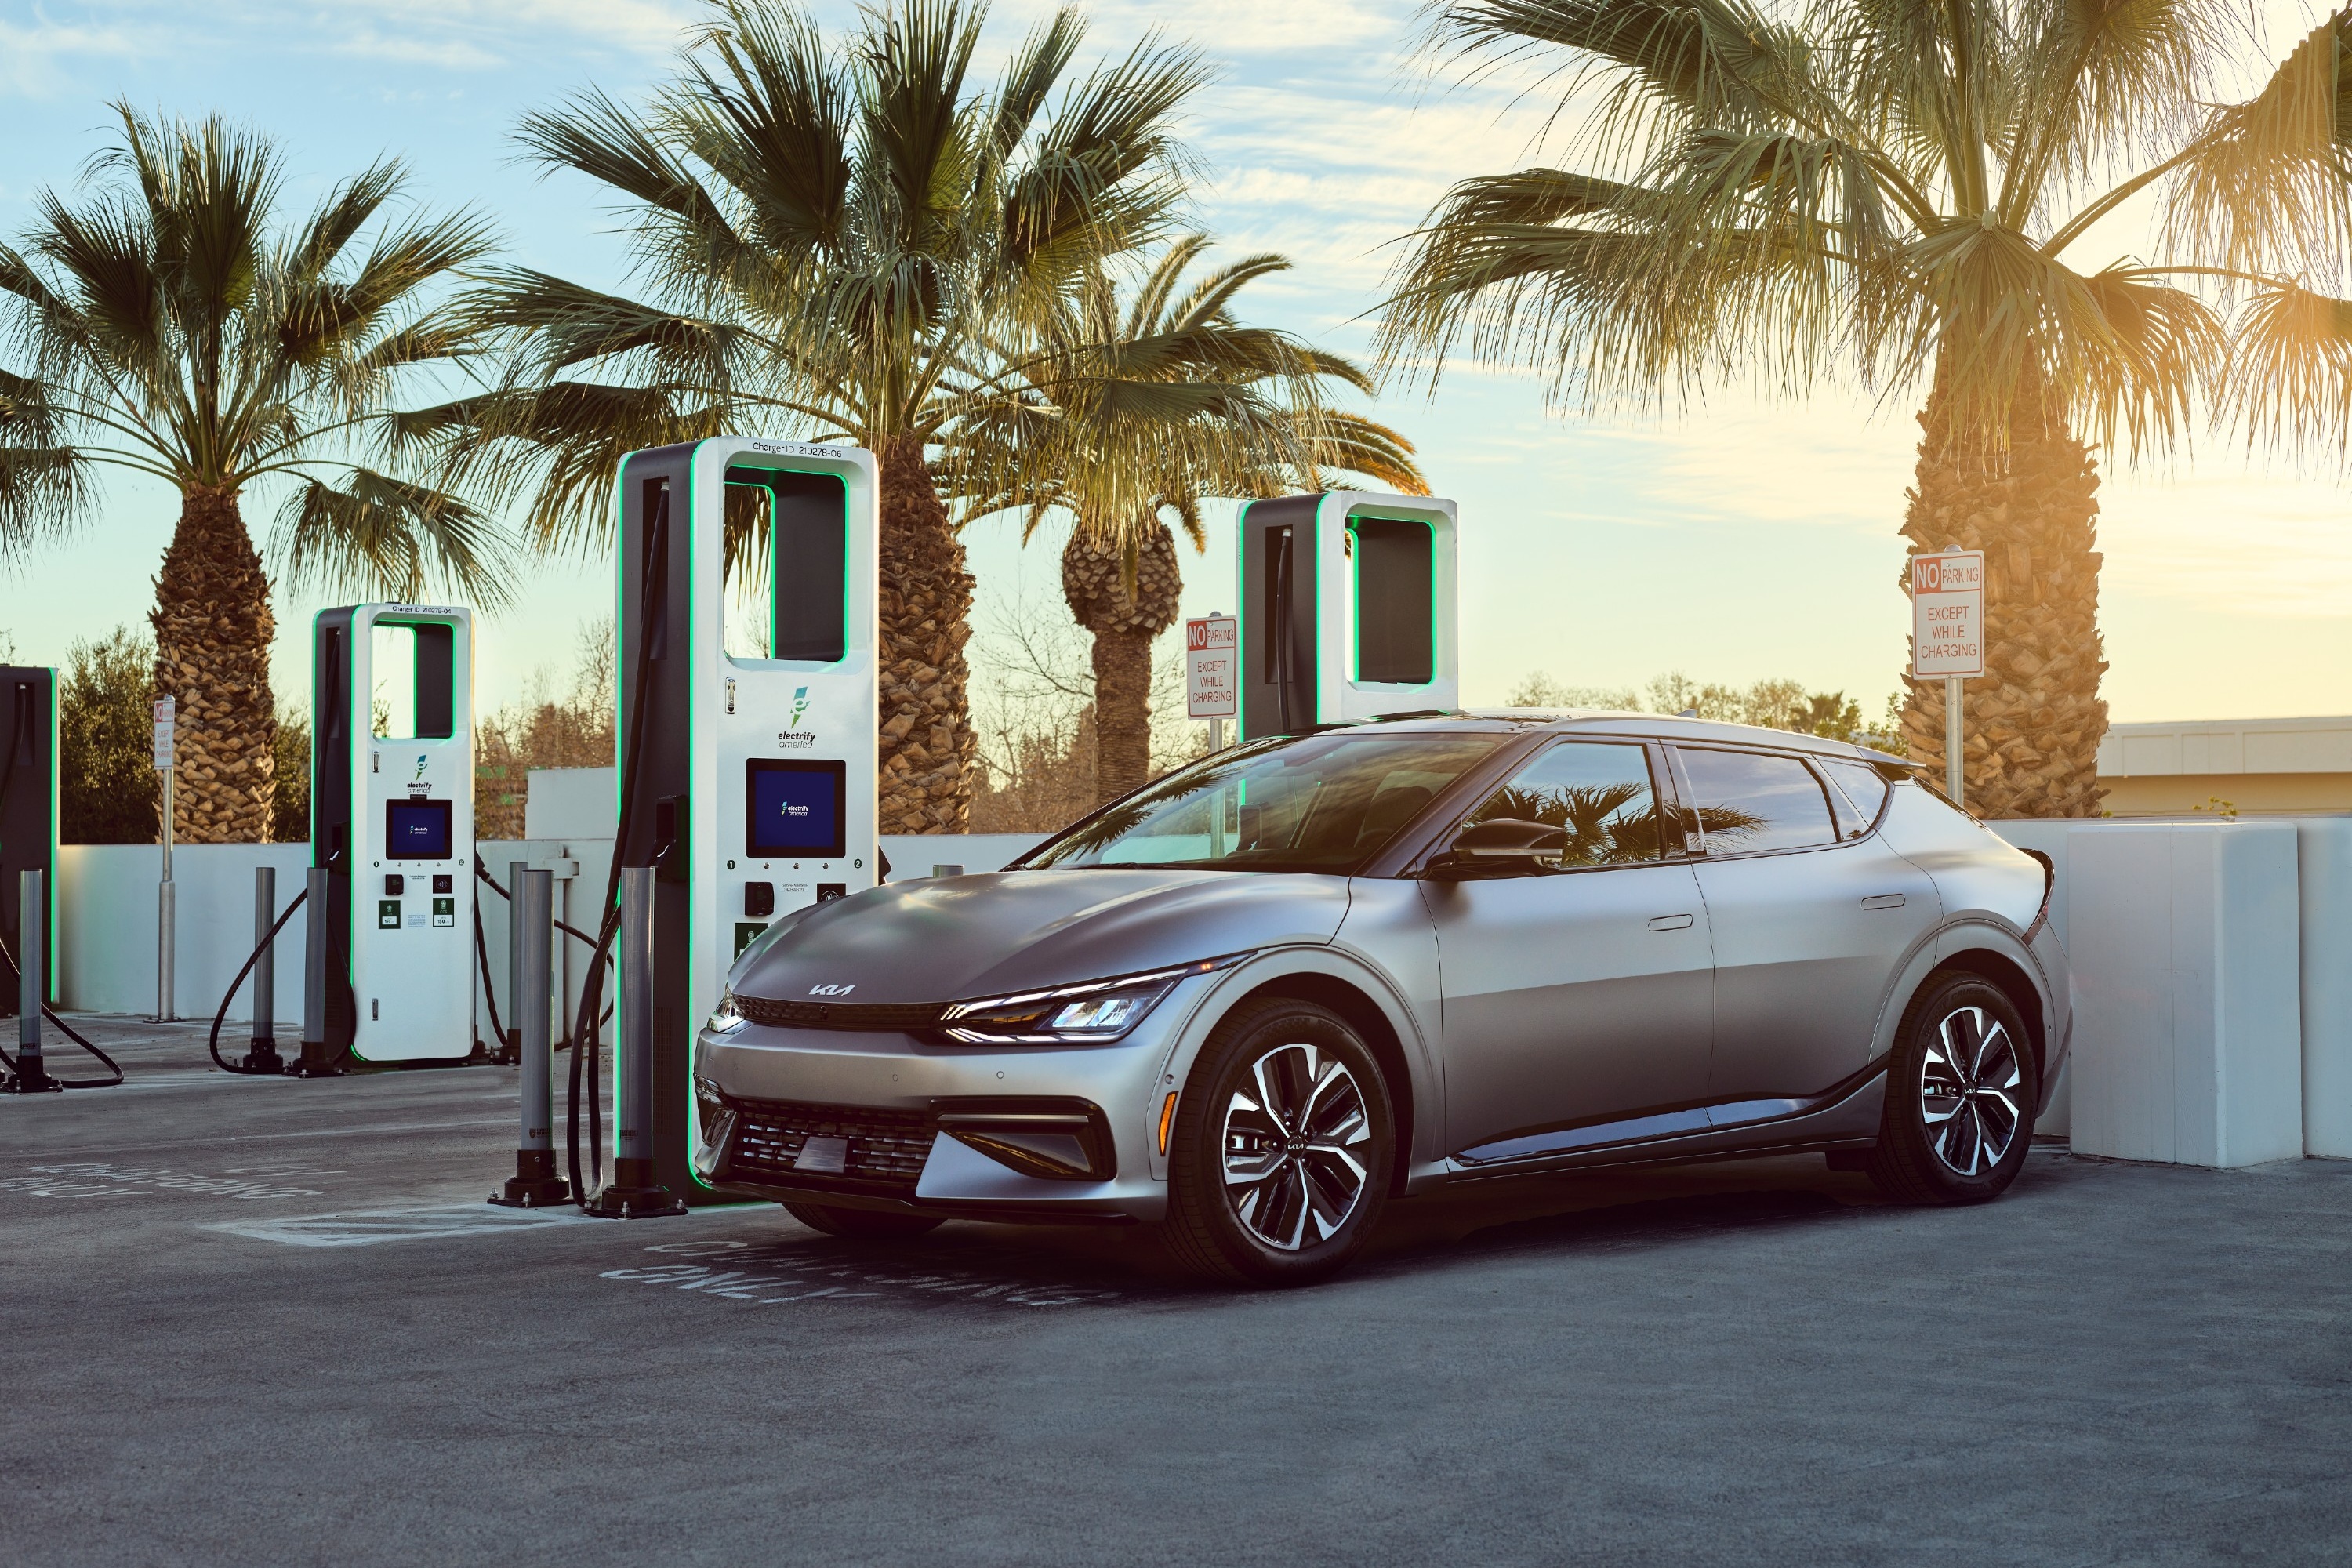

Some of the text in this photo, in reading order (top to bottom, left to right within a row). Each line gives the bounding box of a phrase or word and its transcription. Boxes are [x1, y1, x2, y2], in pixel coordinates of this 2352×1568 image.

[753, 442, 784, 453] Charger
[799, 446, 842, 458] 210278-06
[1916, 563, 1979, 589] NO PARKING
[1928, 605, 1969, 621] EXCEPT
[1189, 625, 1234, 647] NO PARKING
[1932, 625, 1965, 639] WHILE
[1921, 643, 1976, 659] CHARGING
[1197, 660, 1227, 673] EXCEPT
[1200, 676, 1224, 688] WHILE
[1192, 691, 1232, 703] CHARGING
[778, 731, 815, 742] electrify
[808, 984, 855, 996] KIA
